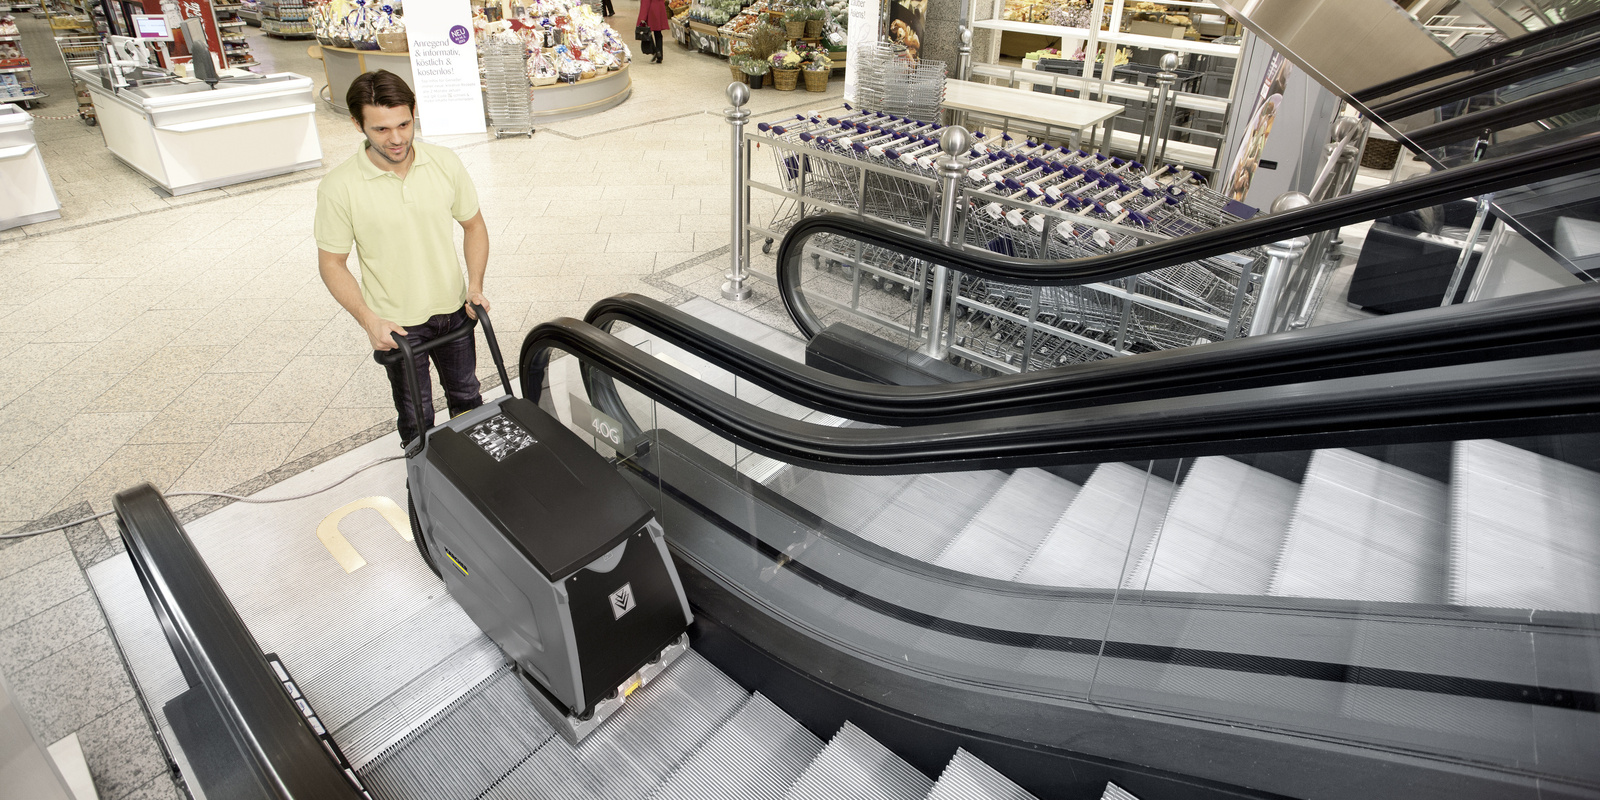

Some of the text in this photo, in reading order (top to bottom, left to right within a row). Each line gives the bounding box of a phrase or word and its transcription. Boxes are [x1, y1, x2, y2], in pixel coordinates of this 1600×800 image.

[451, 27, 466, 38] NEU
[413, 38, 449, 48] Anregend
[414, 48, 461, 57] & informativ,
[415, 57, 452, 67] köstlich &
